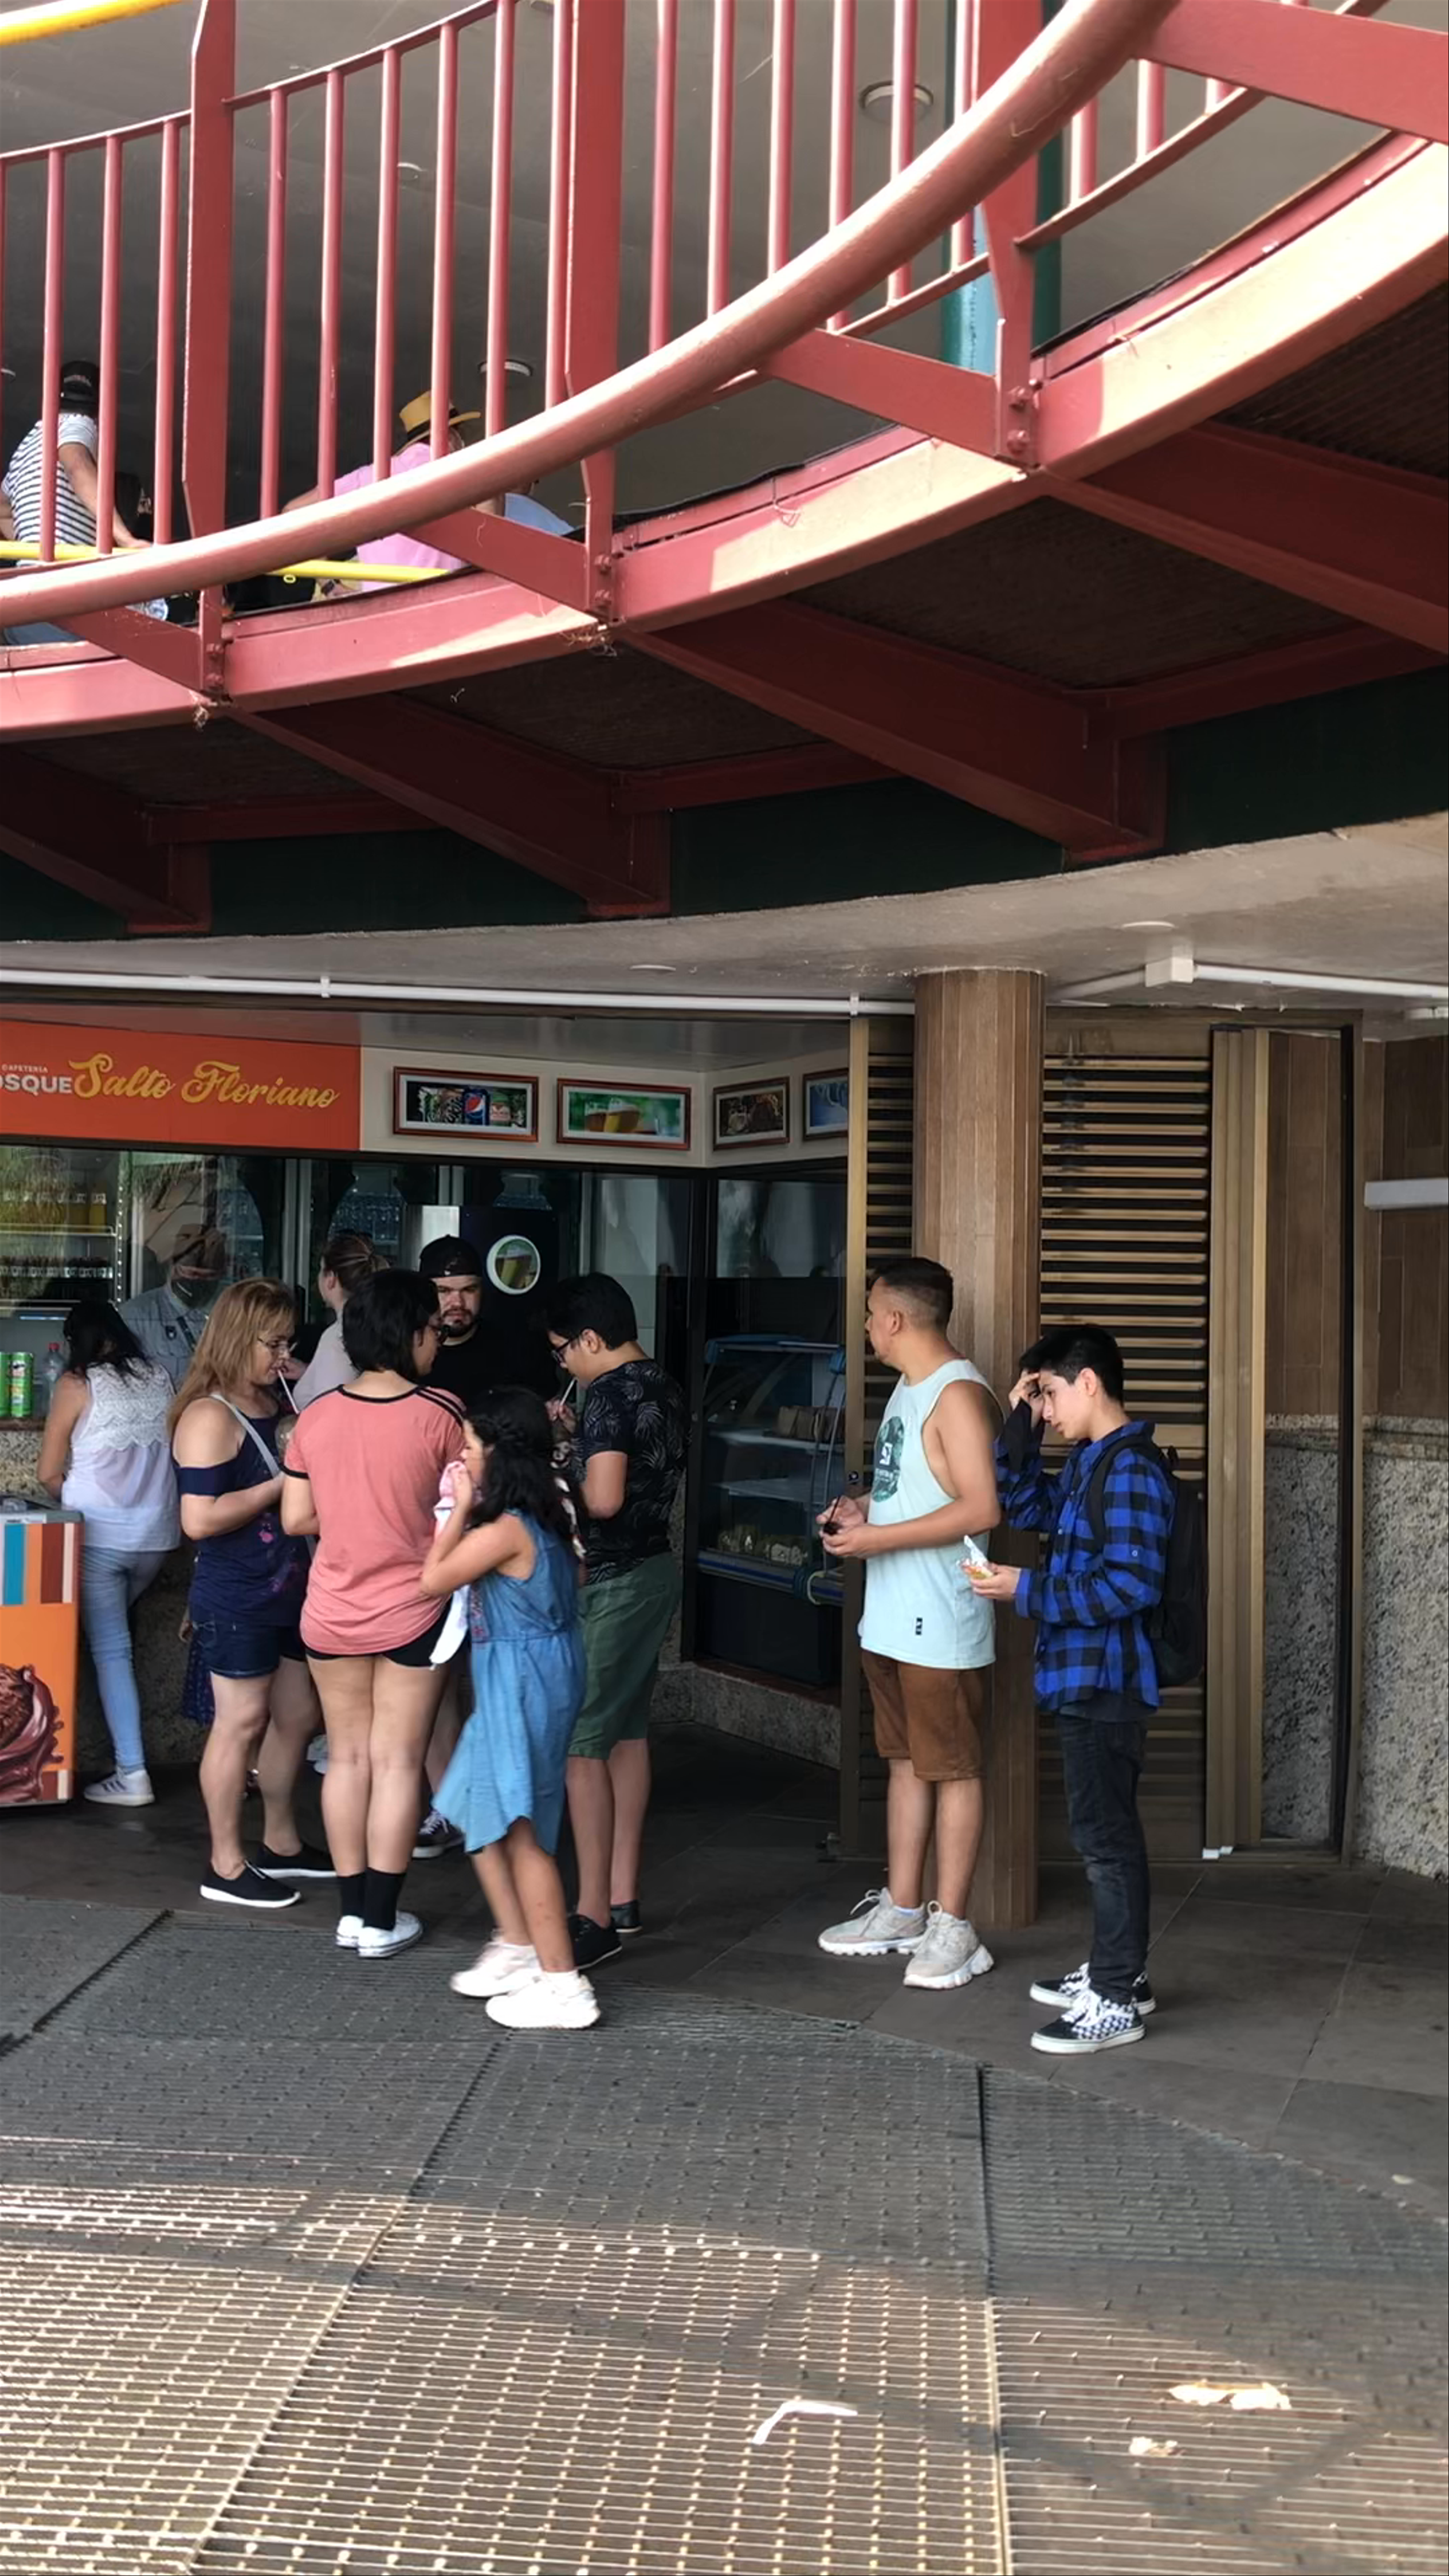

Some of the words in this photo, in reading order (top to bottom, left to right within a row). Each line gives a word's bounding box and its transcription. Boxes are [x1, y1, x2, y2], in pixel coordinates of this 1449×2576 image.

[0, 1073, 72, 1096] SQUE
[68, 1053, 176, 1098] Salto
[181, 1060, 340, 1108] Floriano
[2, 1064, 49, 1073] CAFETERIA
